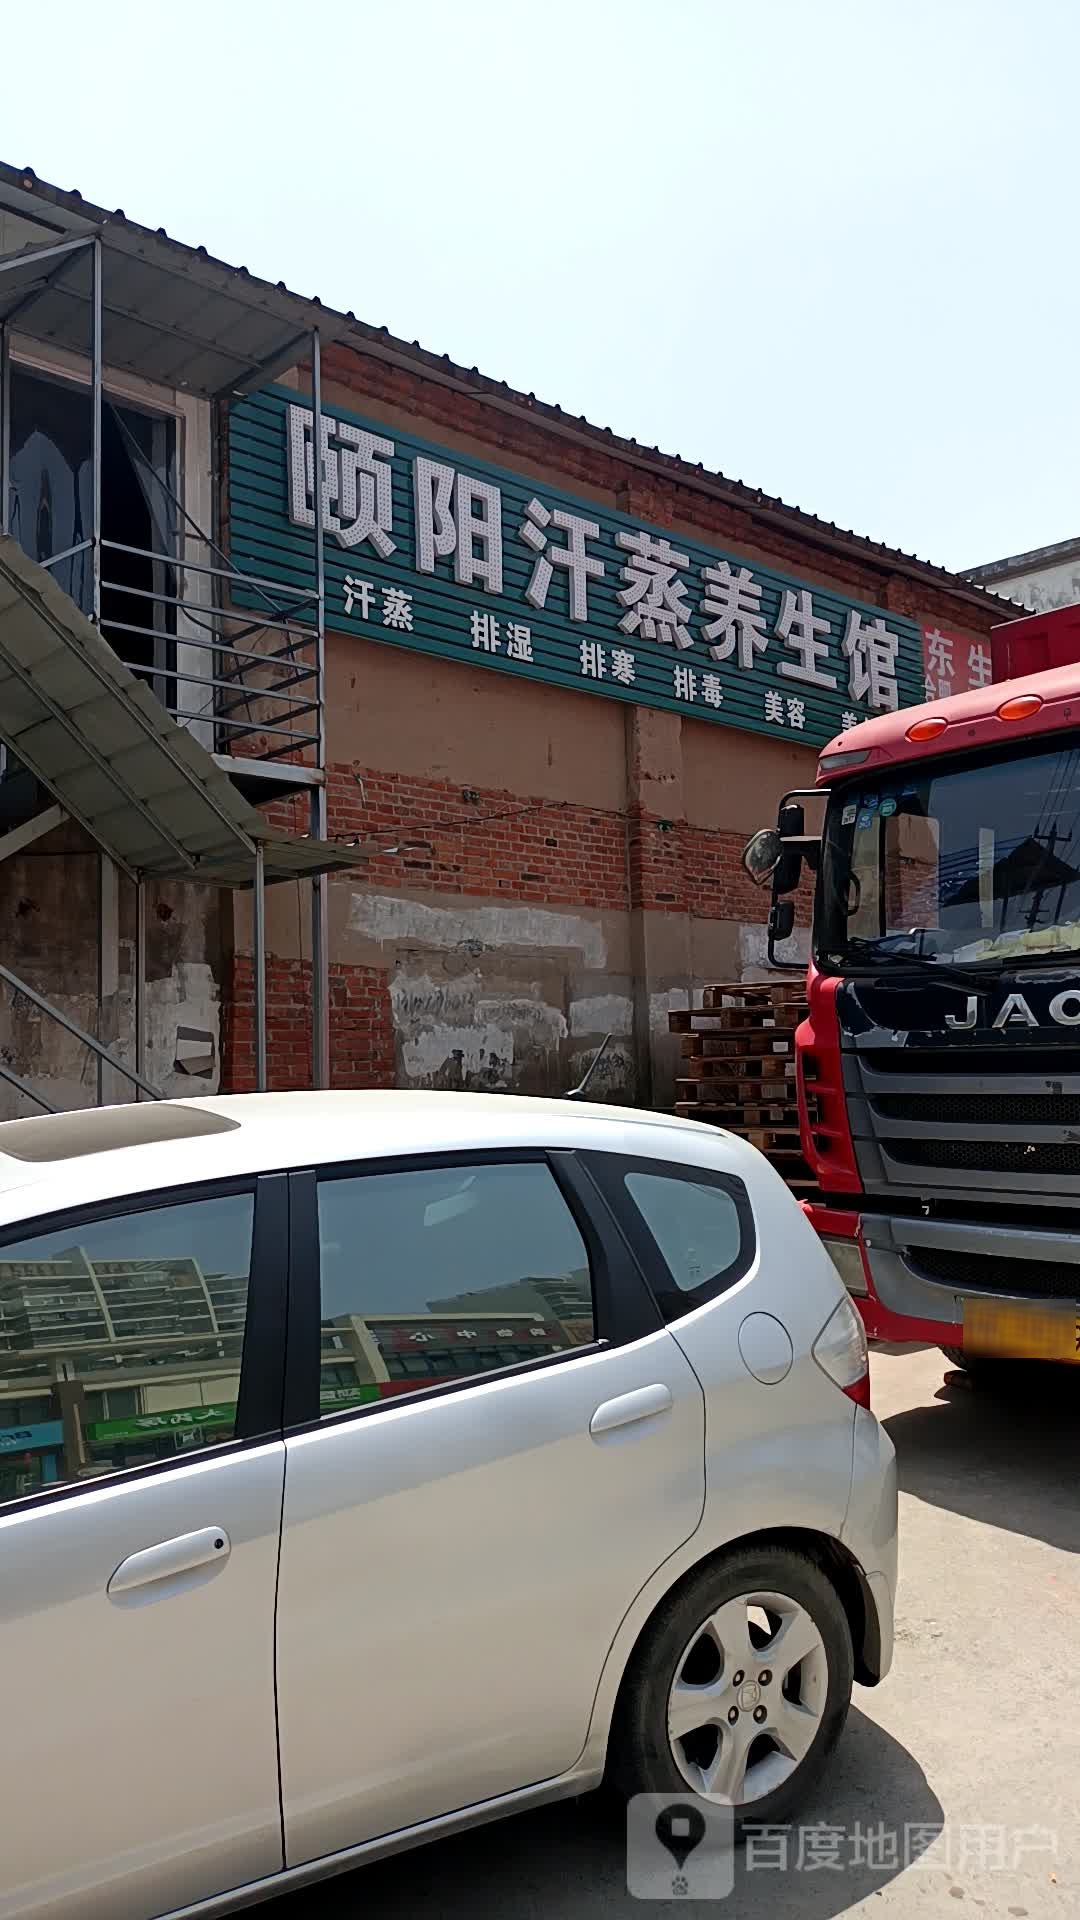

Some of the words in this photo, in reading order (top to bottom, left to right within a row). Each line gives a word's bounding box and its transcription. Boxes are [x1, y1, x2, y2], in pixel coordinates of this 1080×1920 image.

[286, 403, 899, 711] 颐阳汗蒸养生馆
[342, 574, 415, 632] 汗蒸
[470, 610, 534, 663] 排湿
[579, 639, 637, 686] 排寒
[673, 664, 724, 709] 排毒
[764, 690, 807, 730] 美容
